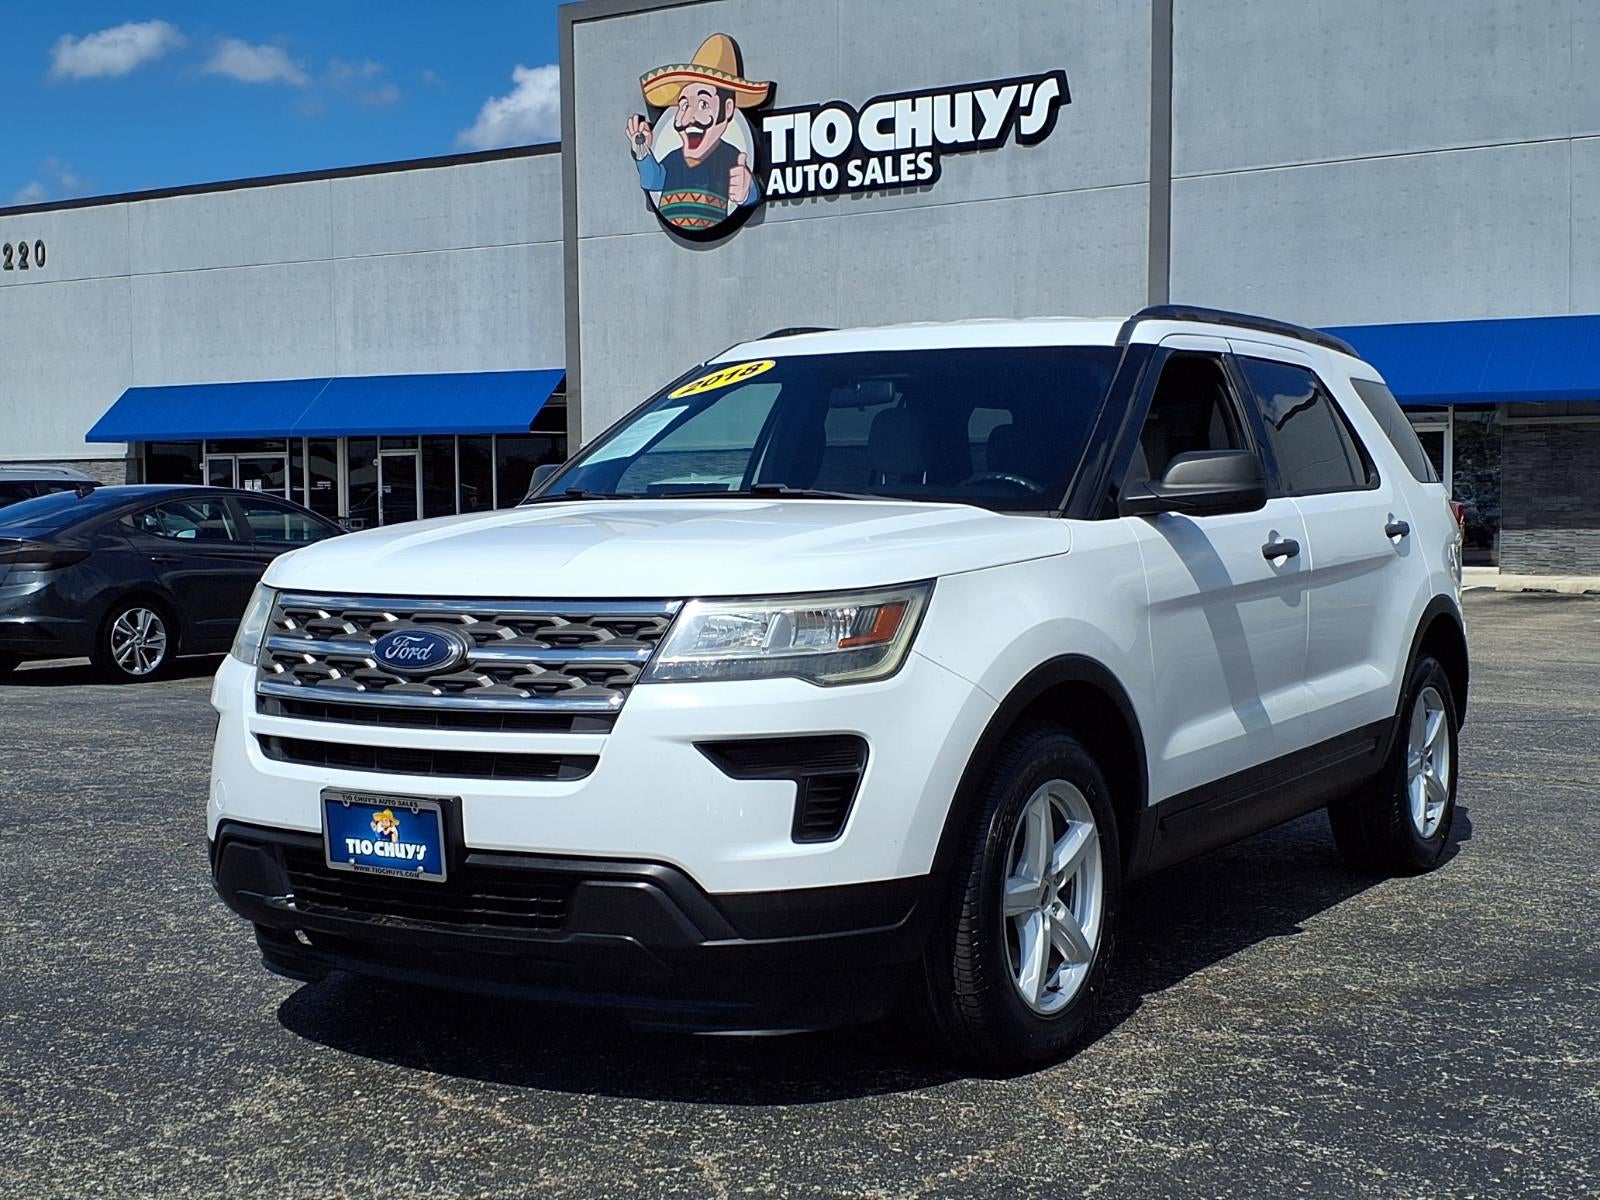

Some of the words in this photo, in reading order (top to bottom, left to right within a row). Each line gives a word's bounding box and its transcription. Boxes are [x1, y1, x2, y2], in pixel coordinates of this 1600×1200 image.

[762, 107, 853, 164] TIO
[857, 77, 1060, 152] CHUY'S
[765, 162, 839, 196] AUTO
[847, 152, 934, 187] SALES
[2, 239, 46, 271] 220
[678, 362, 764, 396] 2018
[385, 635, 435, 661] Ford
[378, 797, 397, 806] AUTO
[398, 799, 418, 808] SALES
[345, 838, 374, 856] TIO
[374, 840, 427, 861] CHUY'S
